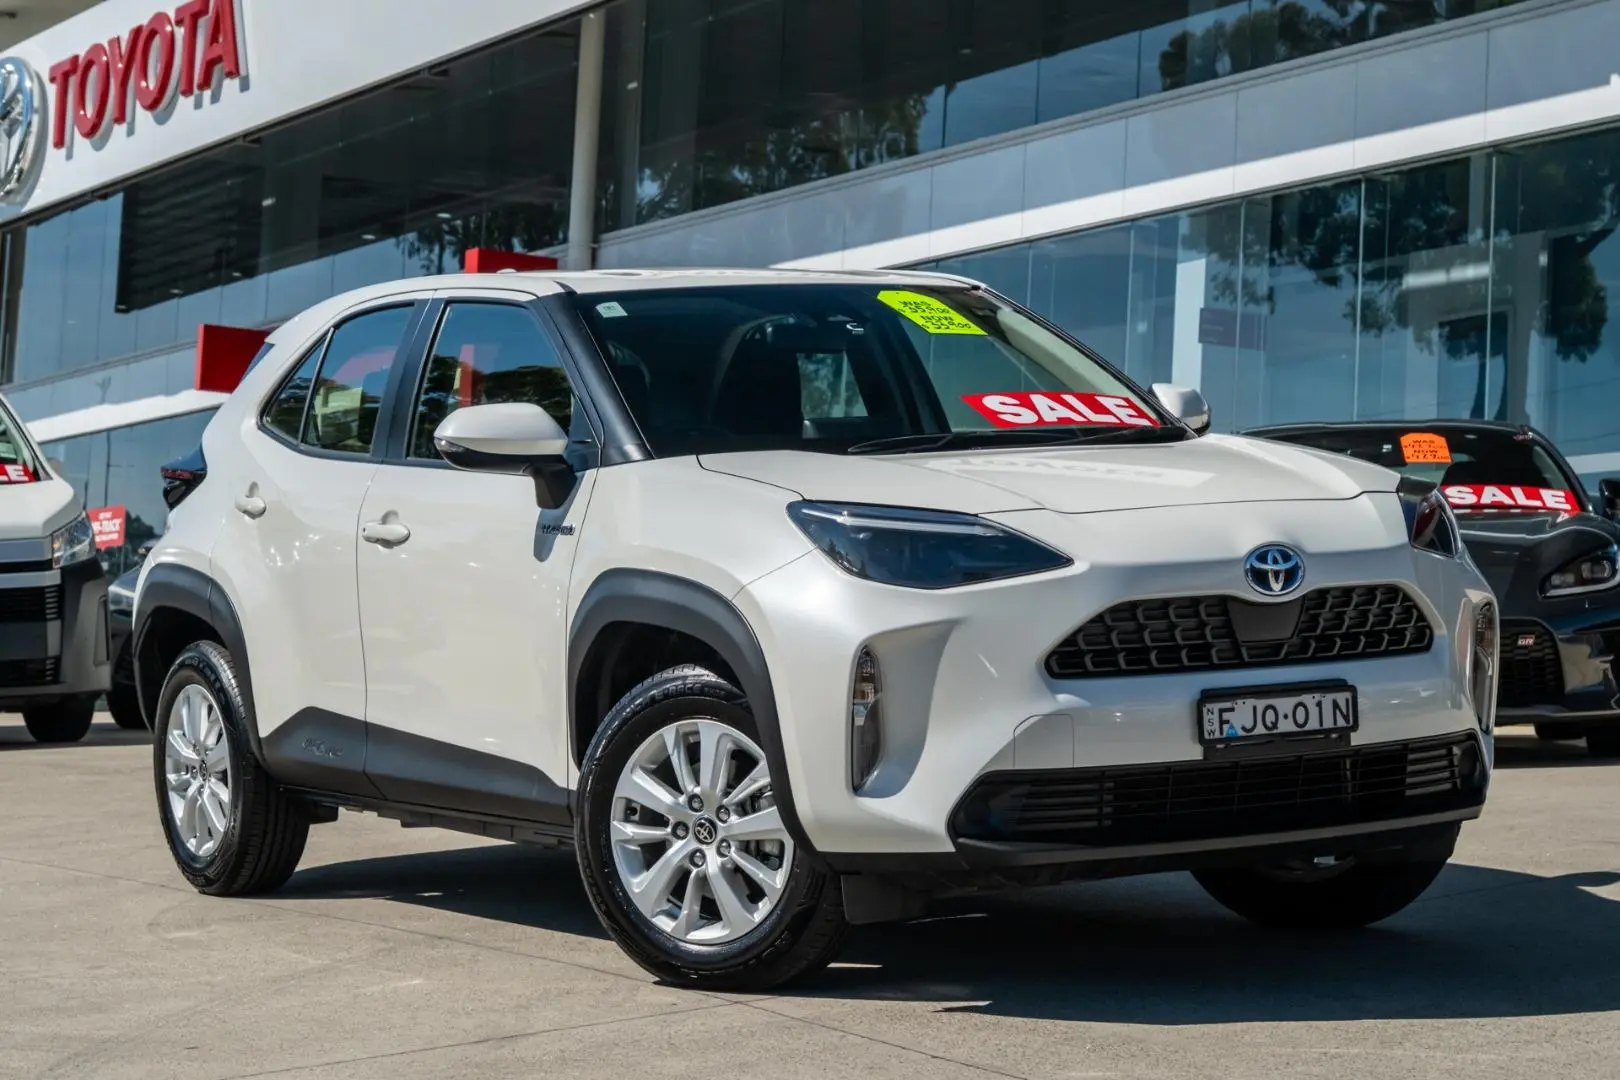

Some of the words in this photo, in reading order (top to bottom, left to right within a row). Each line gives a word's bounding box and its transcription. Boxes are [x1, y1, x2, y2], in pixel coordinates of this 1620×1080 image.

[49, 0, 240, 149] TOYOTA
[981, 393, 1153, 426] SALE
[1443, 486, 1571, 510] SALE
